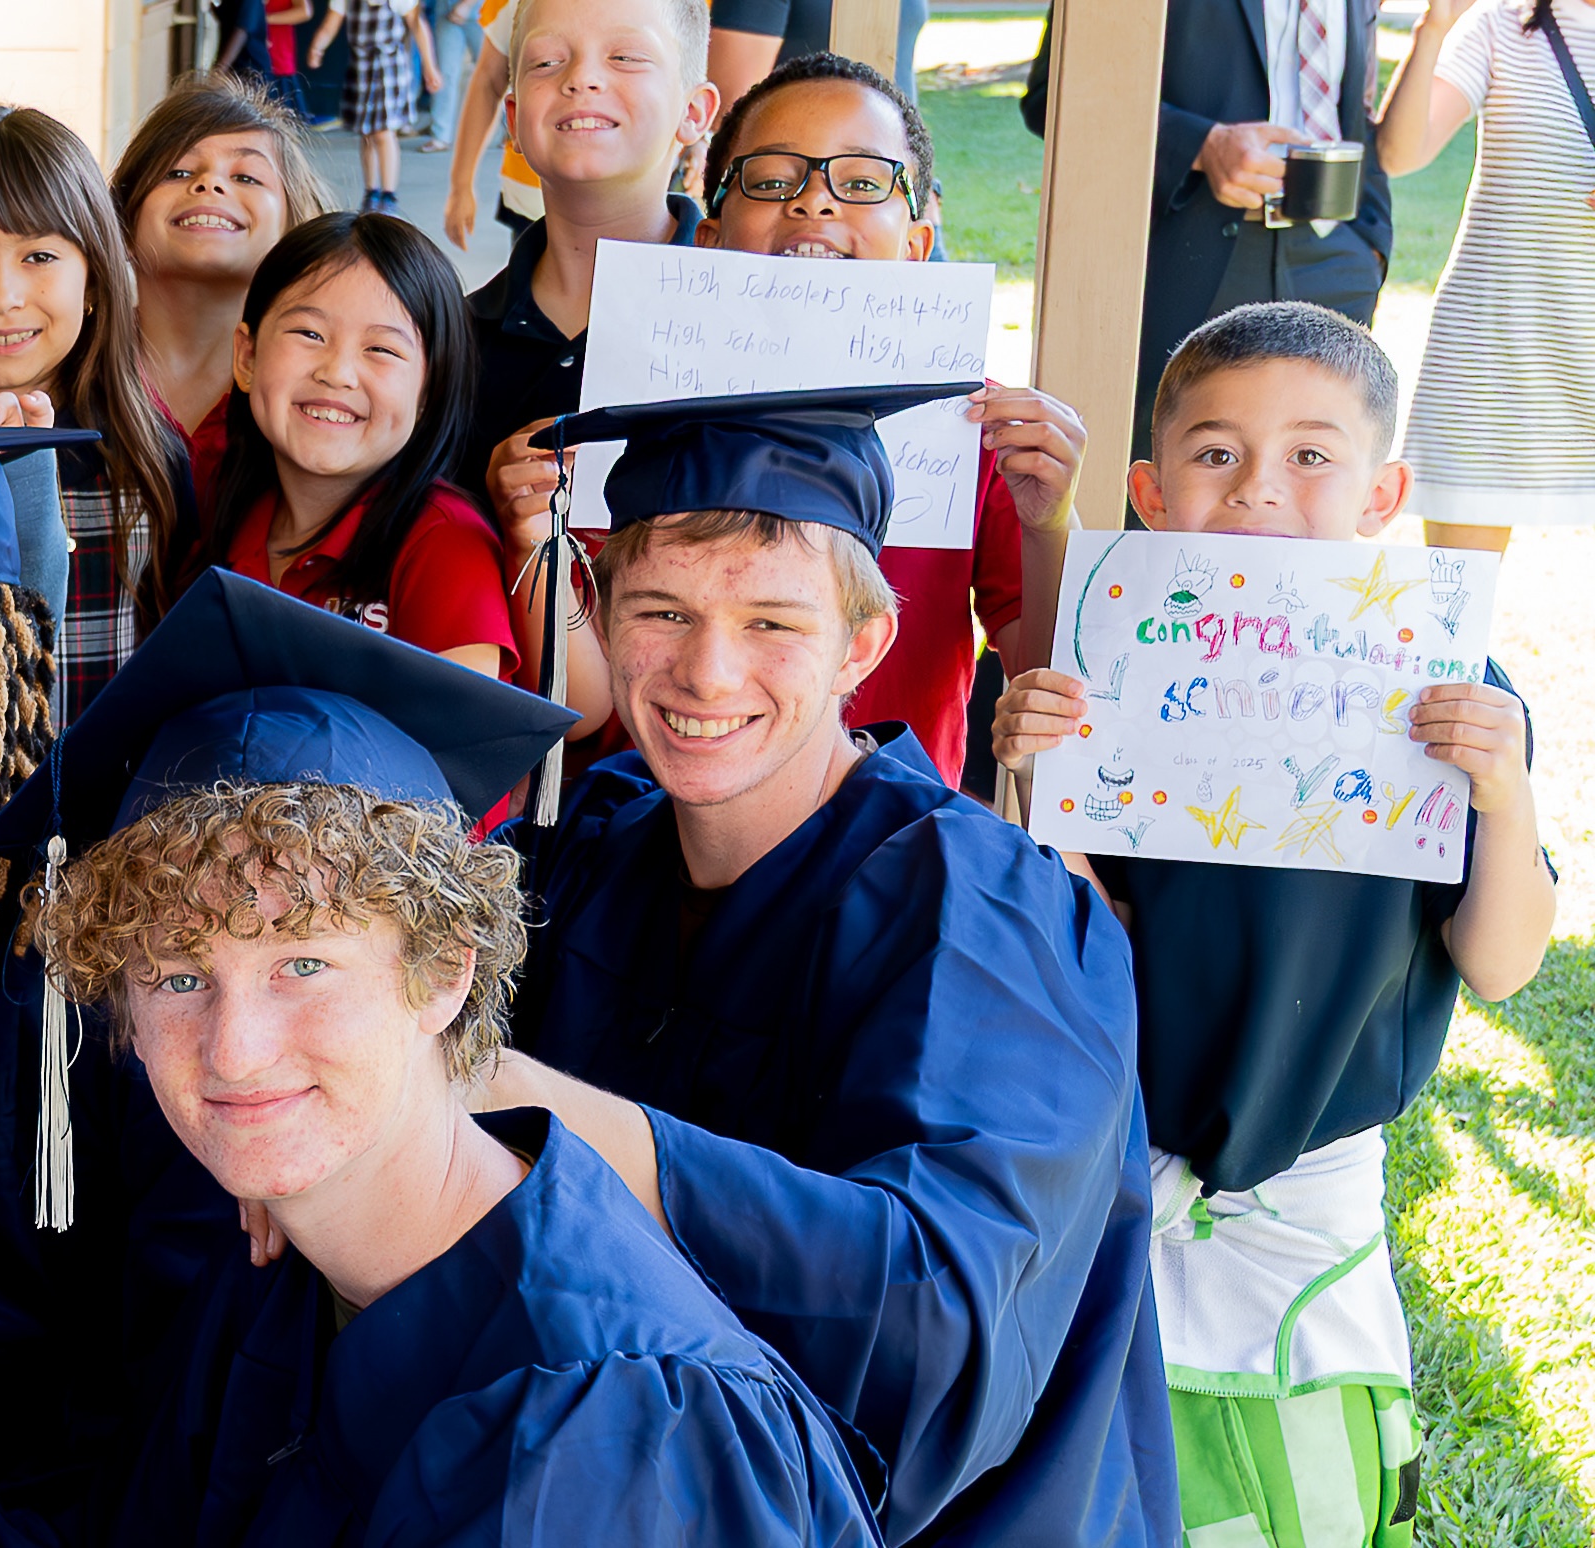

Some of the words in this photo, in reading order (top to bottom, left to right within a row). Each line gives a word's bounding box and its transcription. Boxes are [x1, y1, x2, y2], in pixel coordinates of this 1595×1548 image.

[658, 258, 721, 300] High
[651, 319, 706, 349] High
[849, 324, 905, 371] High
[649, 354, 703, 395] High
[1232, 758, 1267, 771] 2025
